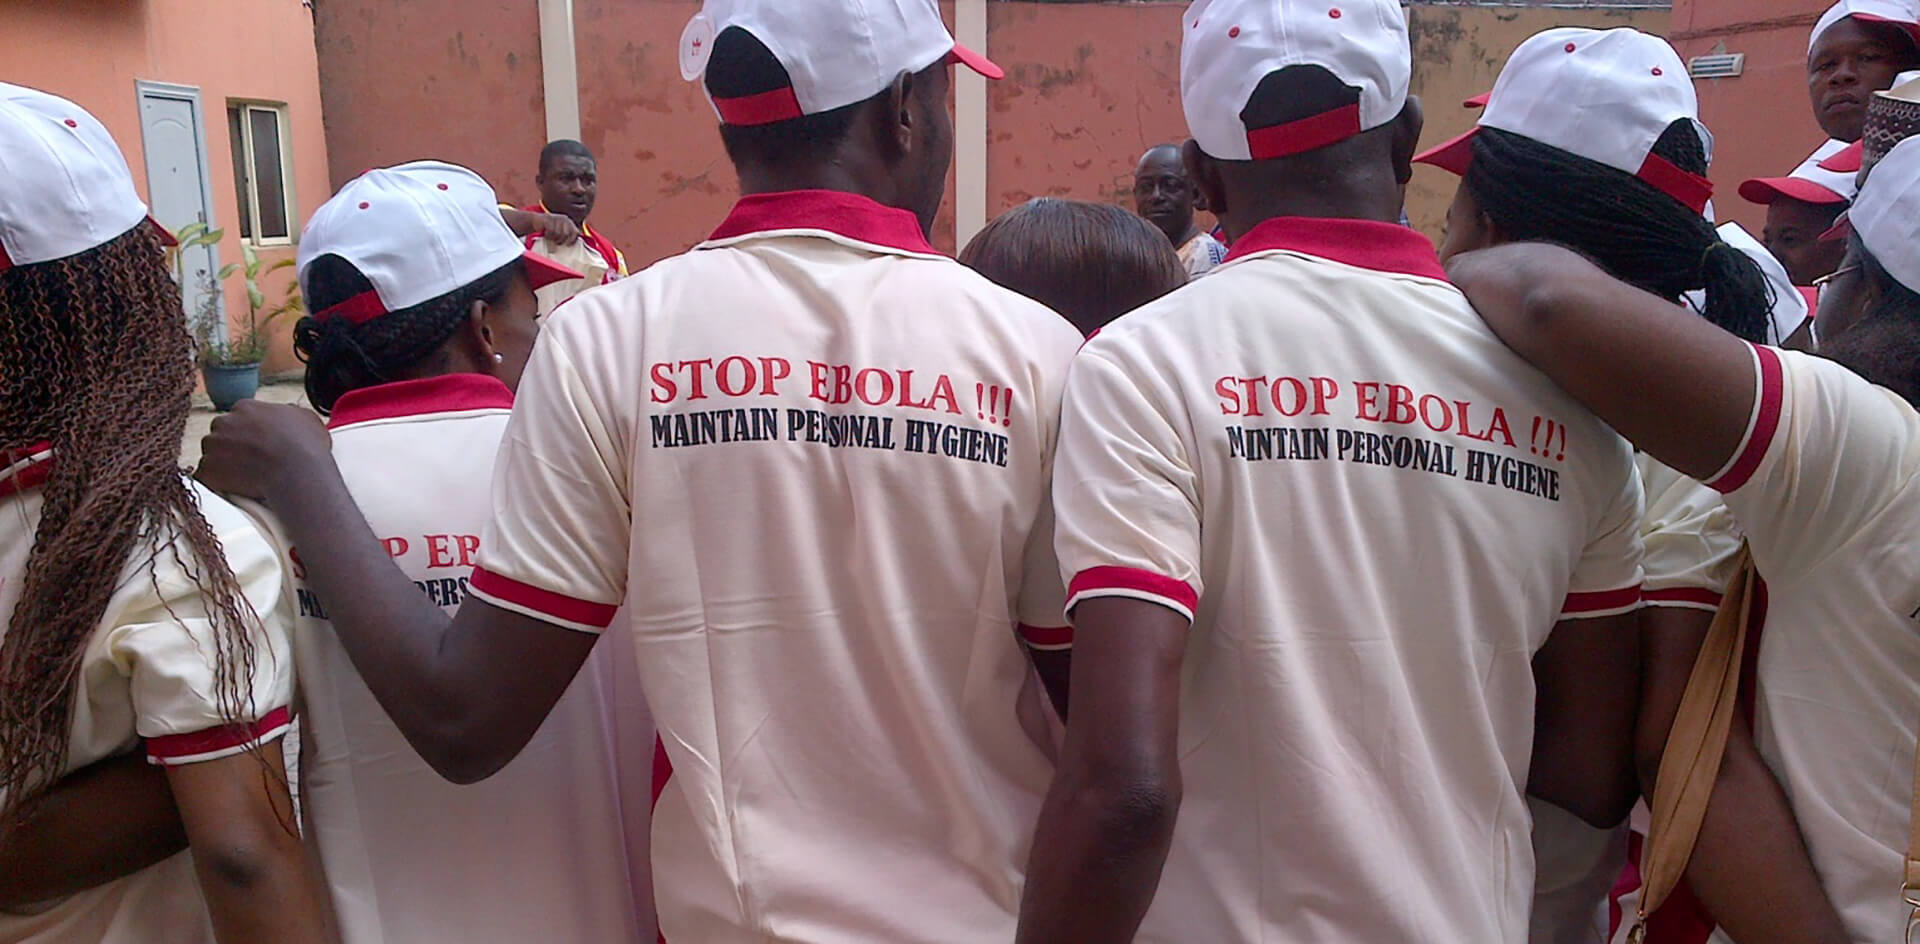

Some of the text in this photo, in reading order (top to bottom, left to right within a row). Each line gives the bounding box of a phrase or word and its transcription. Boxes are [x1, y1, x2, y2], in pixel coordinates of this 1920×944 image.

[650, 355, 1013, 427] STOP EBOLA !!!
[1214, 375, 1567, 462] STOP EBOLA !!!
[650, 407, 779, 449] MAINTAIN
[904, 418, 1009, 468] HYGIENE
[1336, 428, 1457, 477] PERSONAL
[1465, 448, 1561, 502] HYGIENE
